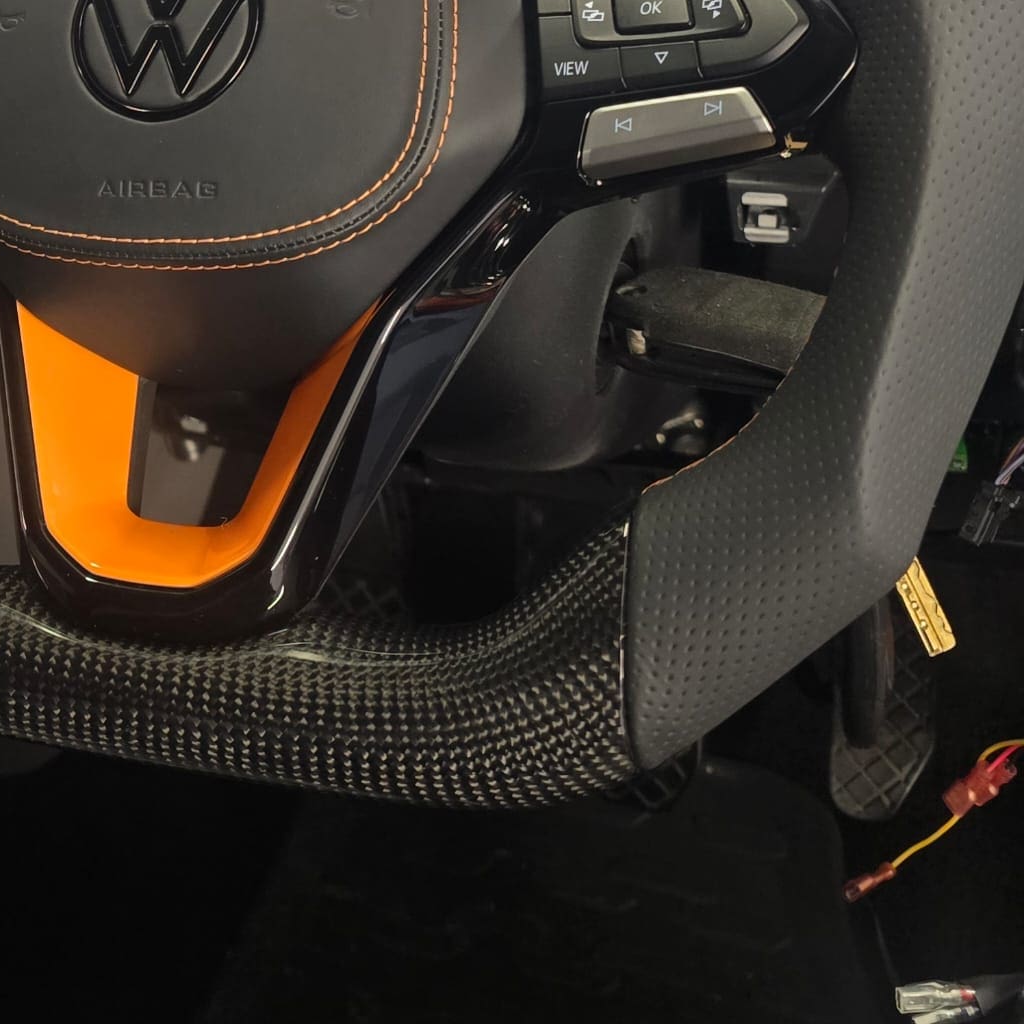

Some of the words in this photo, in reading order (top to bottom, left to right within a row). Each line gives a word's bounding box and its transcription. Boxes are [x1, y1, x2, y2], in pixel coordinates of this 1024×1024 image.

[640, 0, 663, 16] OK
[554, 60, 589, 76] VIEW
[97, 180, 219, 200] AIRBAG
